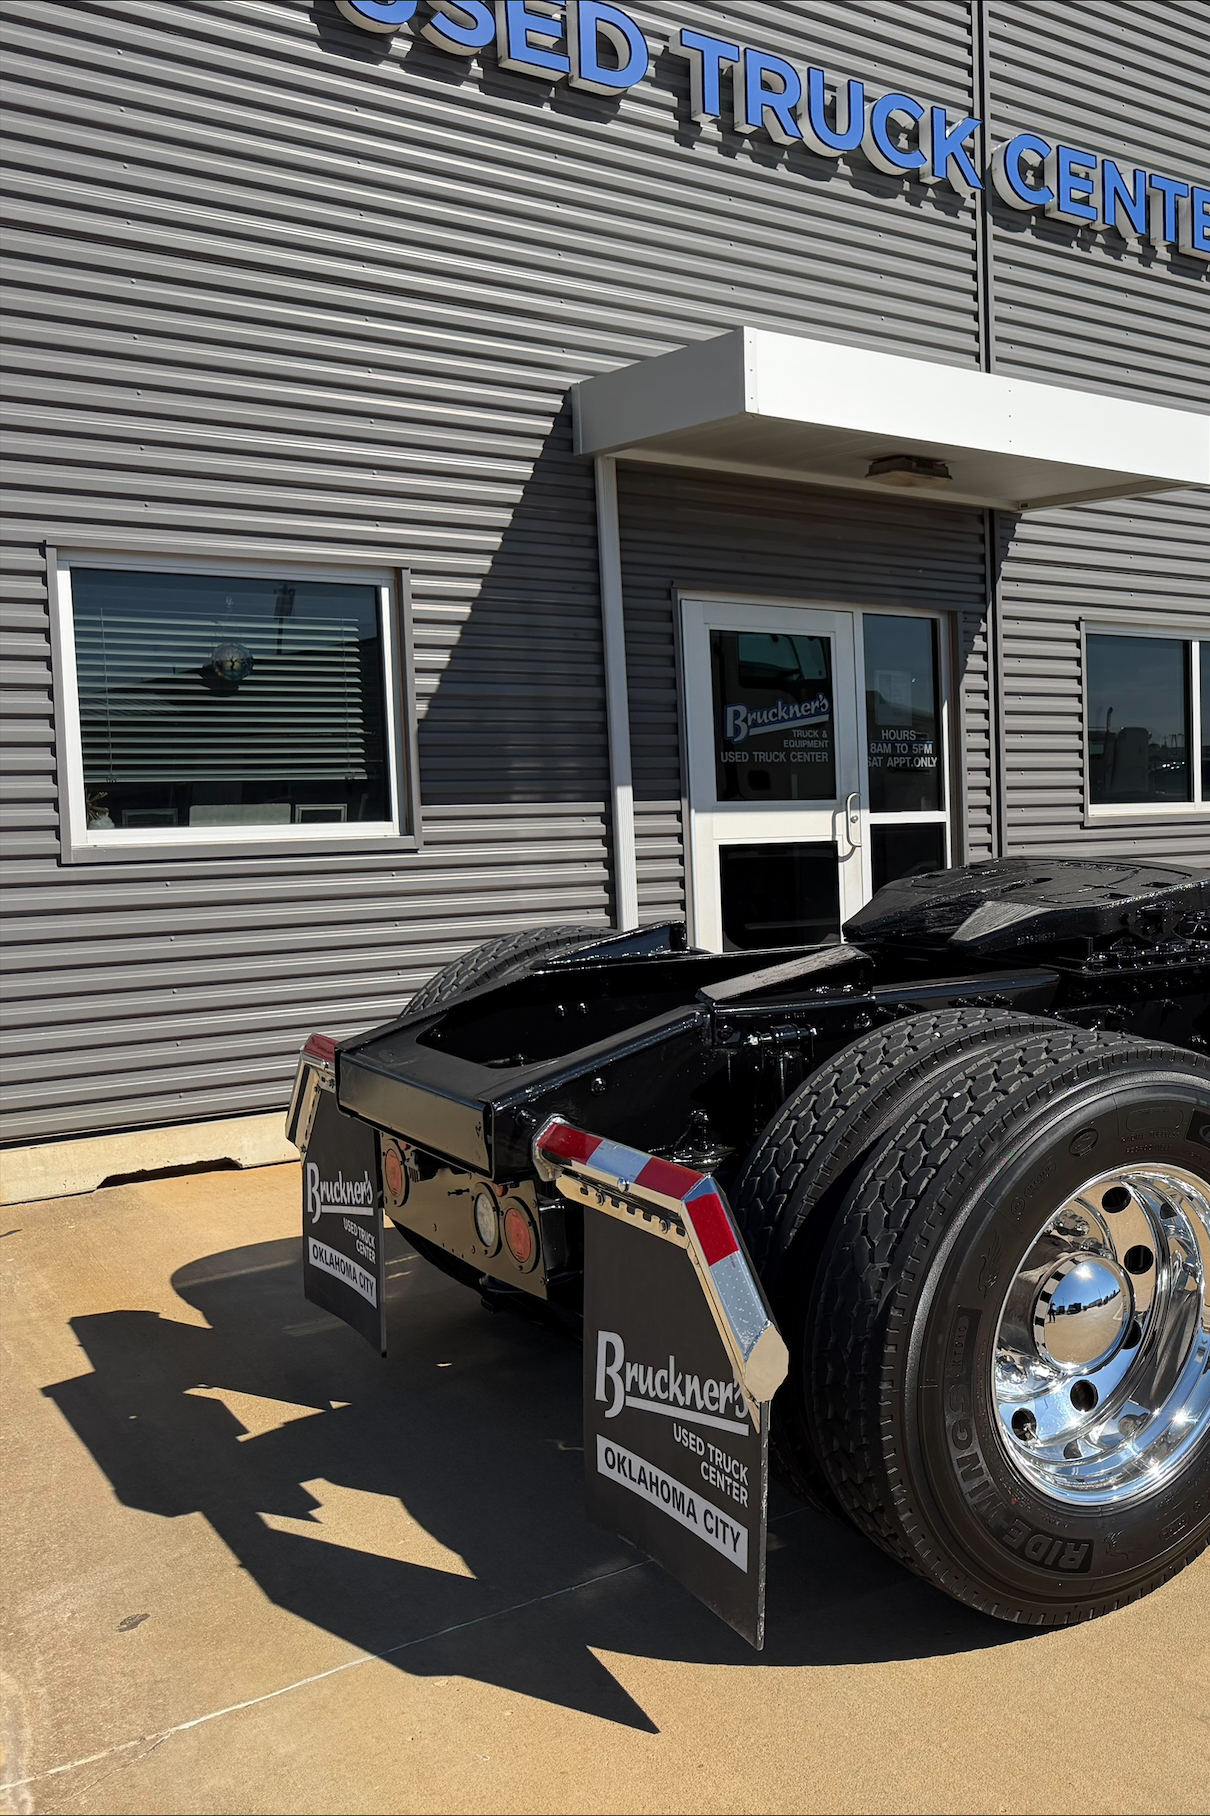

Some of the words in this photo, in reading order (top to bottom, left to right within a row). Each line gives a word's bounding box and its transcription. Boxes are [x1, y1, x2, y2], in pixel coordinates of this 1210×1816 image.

[334, 0, 649, 92] SED
[673, 28, 984, 194] TRUCK
[725, 692, 830, 743] Bruckner's
[792, 730, 820, 739] TRUCK
[822, 730, 828, 738] &
[881, 729, 916, 741] HOURS
[720, 751, 749, 763] USED
[752, 751, 787, 763] TRUCK
[790, 751, 829, 763] CENTER
[783, 739, 829, 749] EQUIPMENT
[867, 756, 883, 768] SAT
[869, 743, 892, 755] 8AM
[895, 743, 908, 755] TO
[912, 743, 933, 755] 5PM
[306, 1162, 373, 1224] Bruckner's
[343, 1217, 358, 1236] USED
[358, 1226, 375, 1250] TRUCK
[356, 1239, 376, 1264] CENTER
[312, 1244, 358, 1284] OKLAHOMA
[358, 1269, 374, 1297] CITY
[673, 1422, 705, 1456] USED
[707, 1443, 749, 1486] TRUCK
[700, 1462, 749, 1508] CENTER
[948, 1384, 1090, 1571] RIDE-WINGS
[604, 1446, 698, 1525] OKLAHOMA
[703, 1509, 742, 1553] CITY
